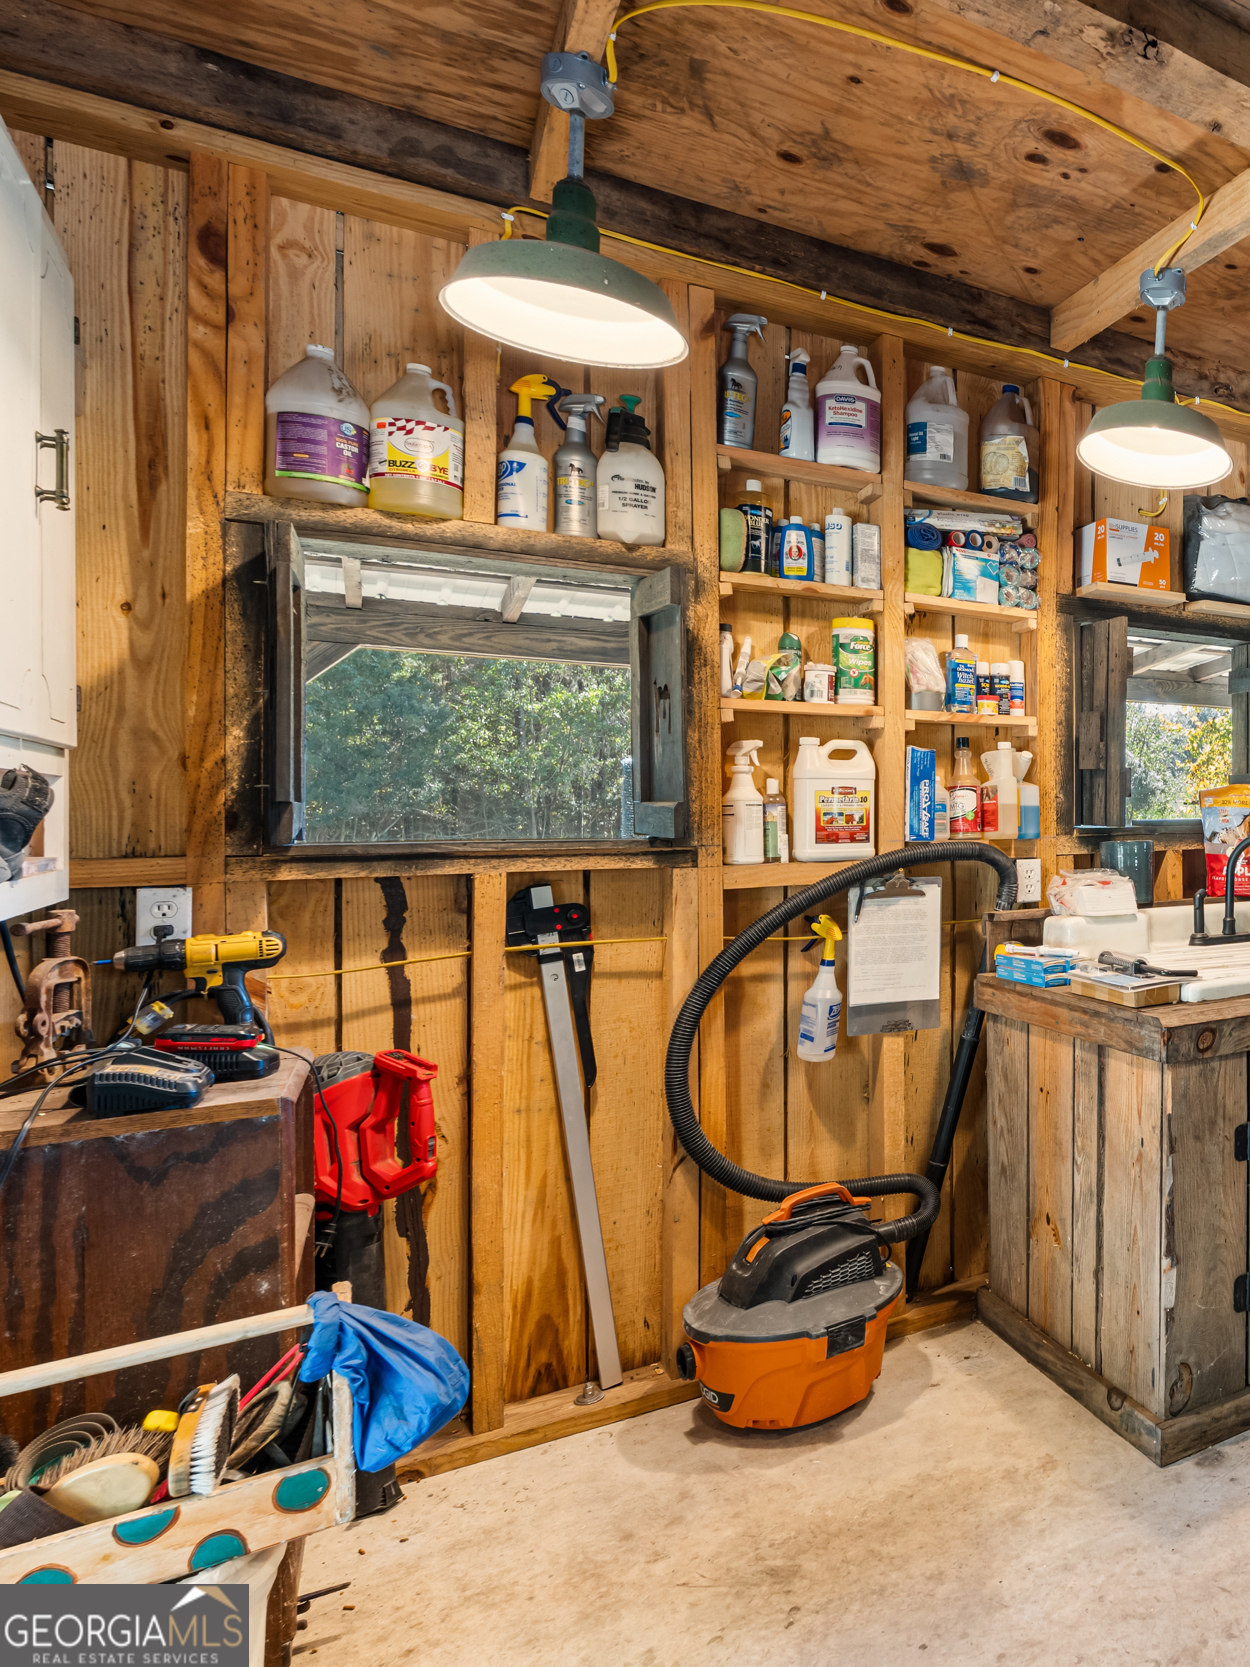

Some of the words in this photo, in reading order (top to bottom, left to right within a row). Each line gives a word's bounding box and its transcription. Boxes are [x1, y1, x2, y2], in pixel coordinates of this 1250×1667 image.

[336, 442, 359, 453] CASTOR
[388, 460, 417, 469] BUZZ
[635, 484, 657, 493] HUDSON
[1097, 525, 1105, 534] 20
[1154, 532, 1165, 542] 20
[850, 642, 870, 650] Force
[849, 658, 872, 666] Wipes
[819, 795, 859, 803] Permethrin
